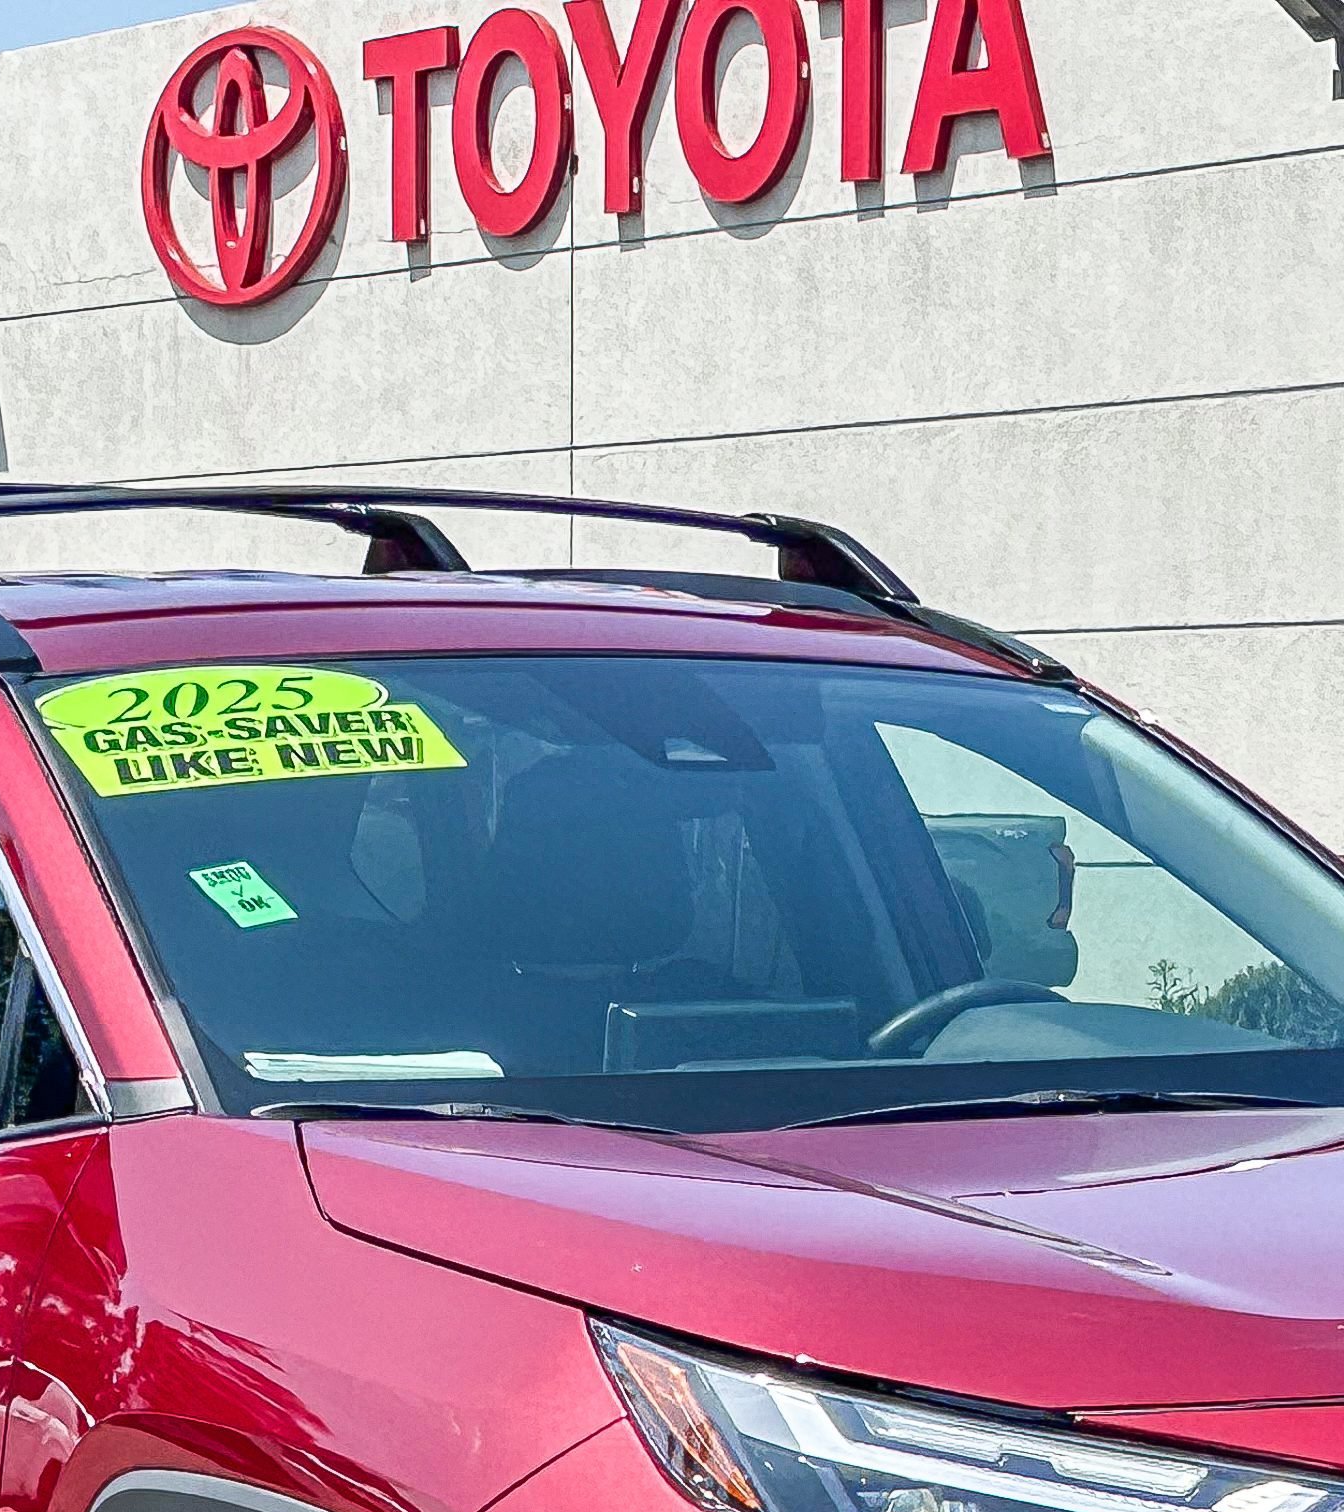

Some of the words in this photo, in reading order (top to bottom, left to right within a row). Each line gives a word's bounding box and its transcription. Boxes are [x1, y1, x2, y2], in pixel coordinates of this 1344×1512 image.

[363, 0, 1052, 243] TOYOTA
[107, 676, 313, 724] 2025
[84, 709, 418, 754] GAS-SAVER
[114, 747, 259, 785] LIKE
[278, 736, 424, 770] NEW
